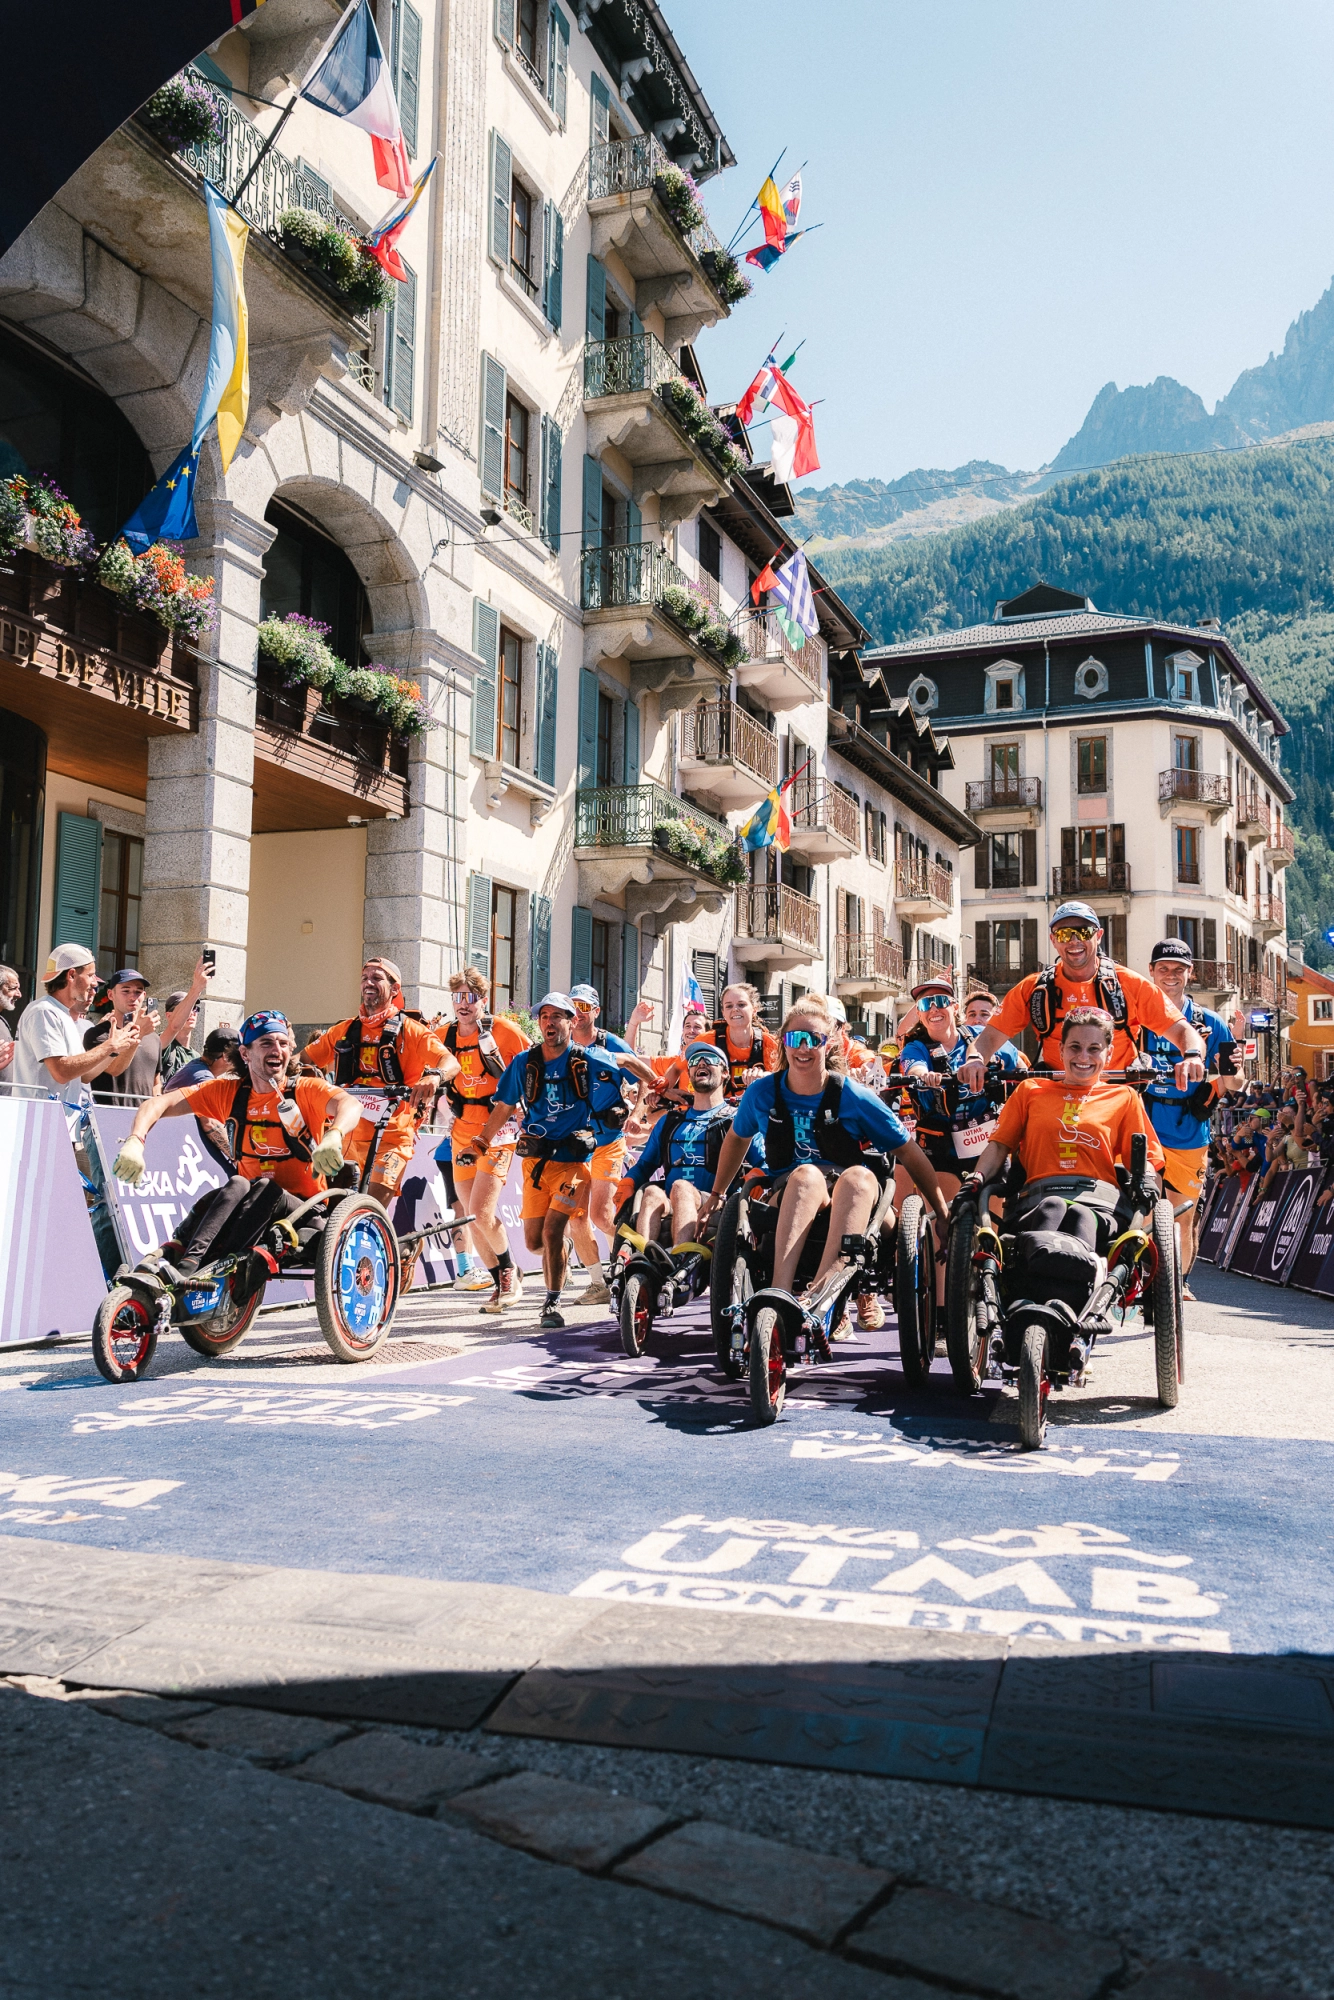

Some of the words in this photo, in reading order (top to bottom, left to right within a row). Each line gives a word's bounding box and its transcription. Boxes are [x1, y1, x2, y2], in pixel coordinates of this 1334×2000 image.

[56, 643, 103, 687] DE
[112, 664, 184, 720] VILLE
[963, 1132, 990, 1147] GUIDE
[116, 1396, 442, 1421] UTMB
[789, 1440, 1182, 1481] HOKA
[660, 1514, 922, 1550] HOKA
[620, 1531, 1222, 1618] UTMB
